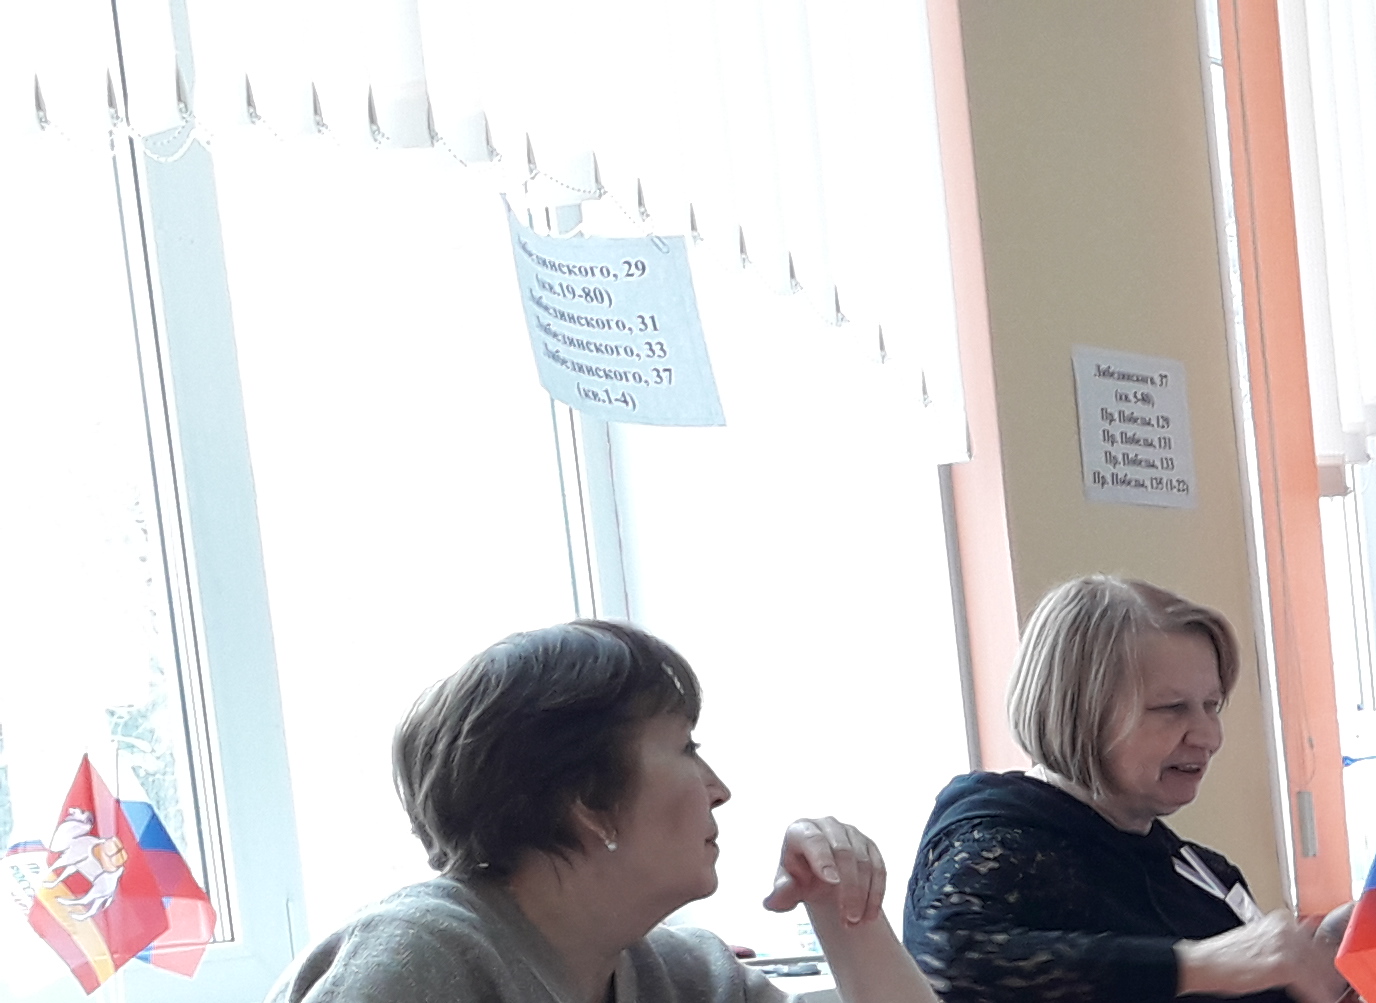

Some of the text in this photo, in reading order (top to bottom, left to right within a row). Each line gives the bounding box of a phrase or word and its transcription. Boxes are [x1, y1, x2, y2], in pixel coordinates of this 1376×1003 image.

[622, 259, 647, 278] 29
[638, 314, 660, 332] 31
[645, 341, 668, 359] 33
[653, 368, 673, 385] 37
